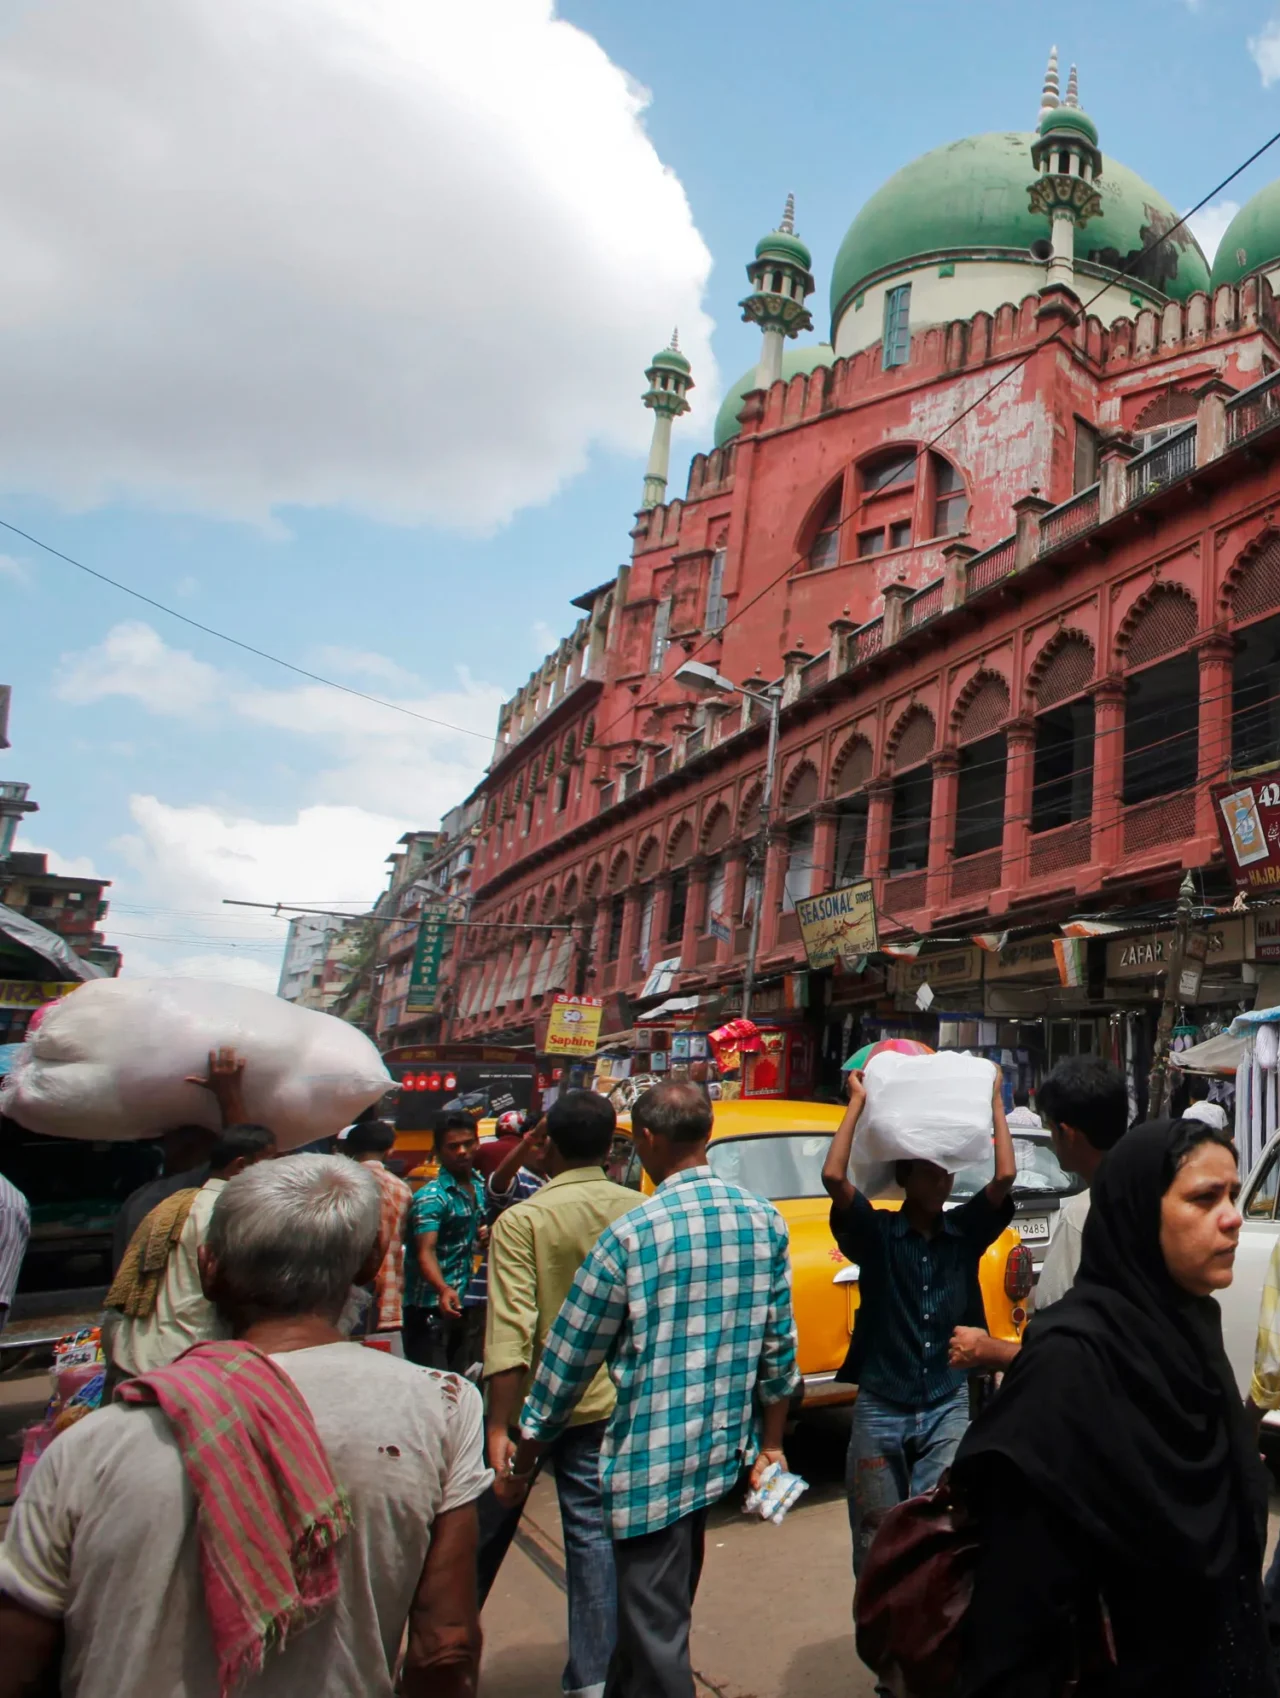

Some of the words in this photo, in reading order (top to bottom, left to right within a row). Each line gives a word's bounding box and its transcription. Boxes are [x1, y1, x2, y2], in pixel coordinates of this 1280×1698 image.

[800, 891, 854, 926] SEASONAL
[855, 890, 873, 904] STORES
[421, 915, 441, 984] PUNJABI
[1119, 940, 1163, 968] ZAFAR
[557, 994, 602, 1007] SALE
[549, 1034, 595, 1048] Saphire
[1022, 1223, 1045, 1234] 9485
